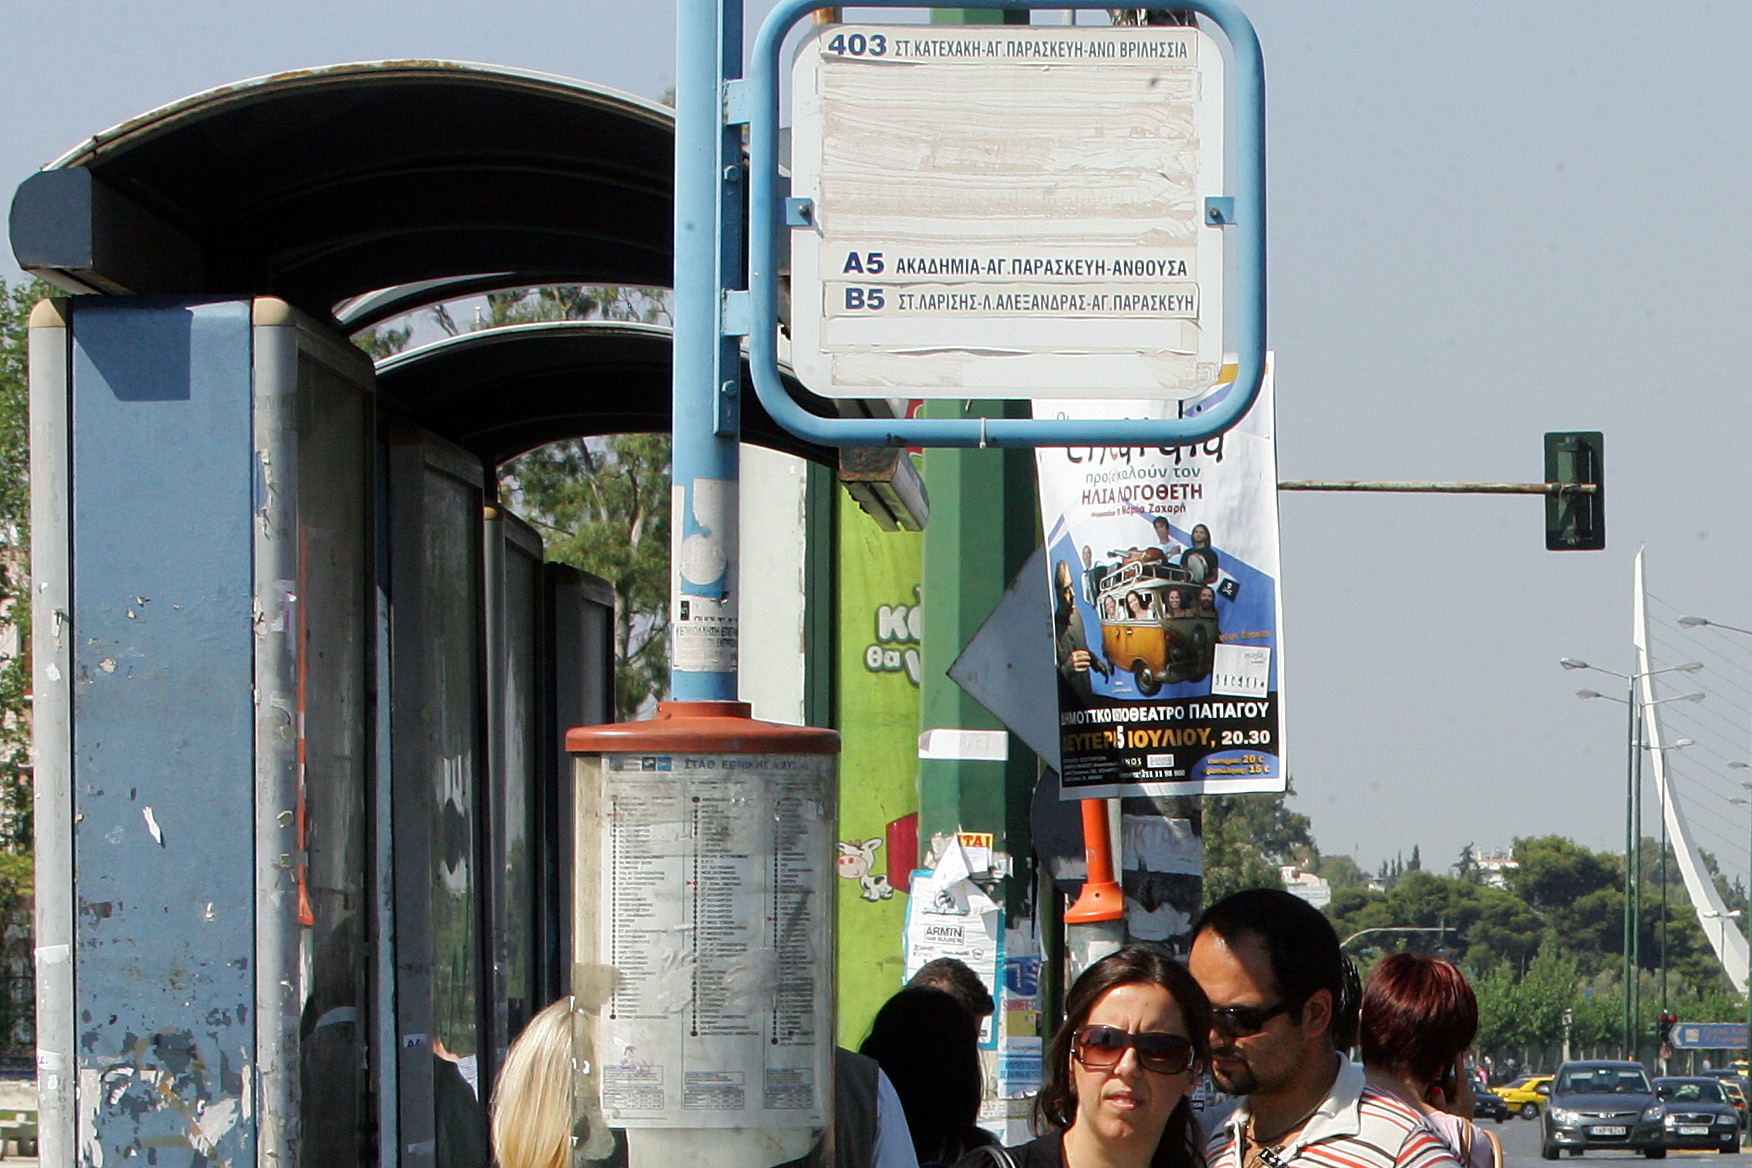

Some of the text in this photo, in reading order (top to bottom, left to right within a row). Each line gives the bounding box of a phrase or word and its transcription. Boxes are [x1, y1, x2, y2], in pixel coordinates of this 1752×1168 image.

[828, 33, 887, 56] 403
[1119, 40, 1188, 59] ΒΡΙΛΗΣΣΙΑ
[1173, 466, 1201, 479] τον
[1082, 483, 1203, 505] ΗΛΙΑ ΛΟΓΟΘΕΤΗ
[1148, 502, 1187, 515] Ζαχαρή
[865, 645, 901, 668] θα
[1189, 701, 1270, 719] ΠΑΠΑΓΟΥ
[1127, 727, 1217, 749] ΙΟΥΛΙΟΥ,
[1221, 729, 1271, 745] 20.30
